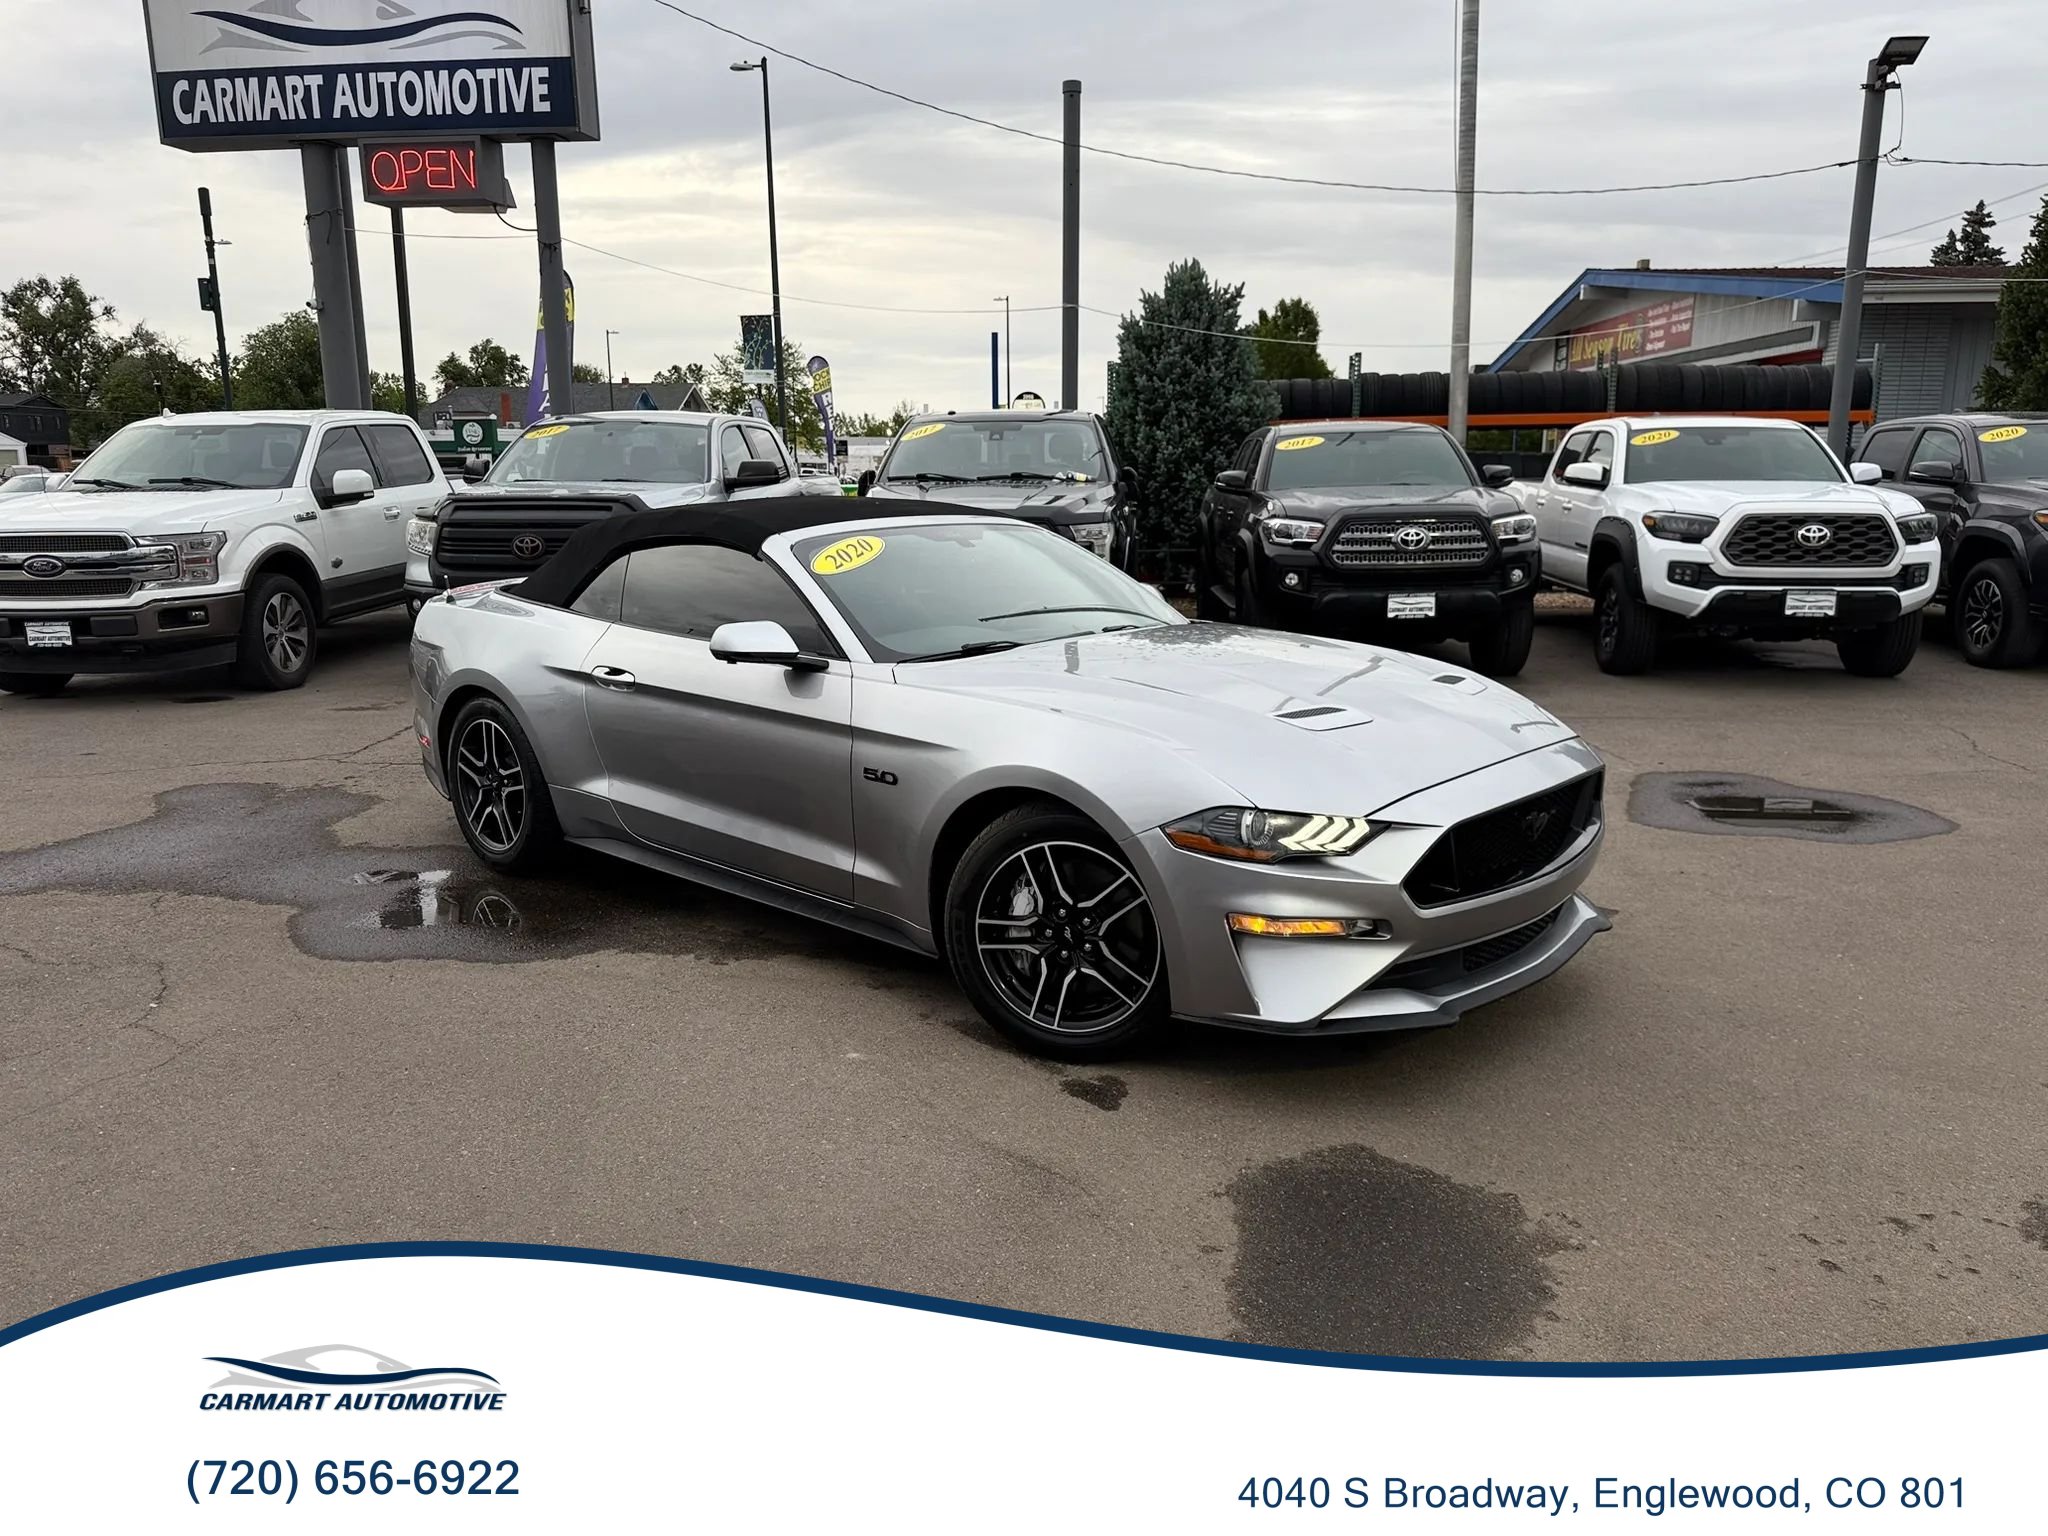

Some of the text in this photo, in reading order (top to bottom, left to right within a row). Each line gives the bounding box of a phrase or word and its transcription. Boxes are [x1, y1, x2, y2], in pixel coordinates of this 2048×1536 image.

[172, 67, 551, 125] CARMART AUTOMOTIVE
[371, 149, 477, 191] OPEN
[1284, 437, 1315, 449] 2017
[1640, 431, 1671, 444] 2020
[1990, 427, 2018, 441] 2020
[824, 538, 874, 570] 2020
[863, 766, 899, 786] 5.0
